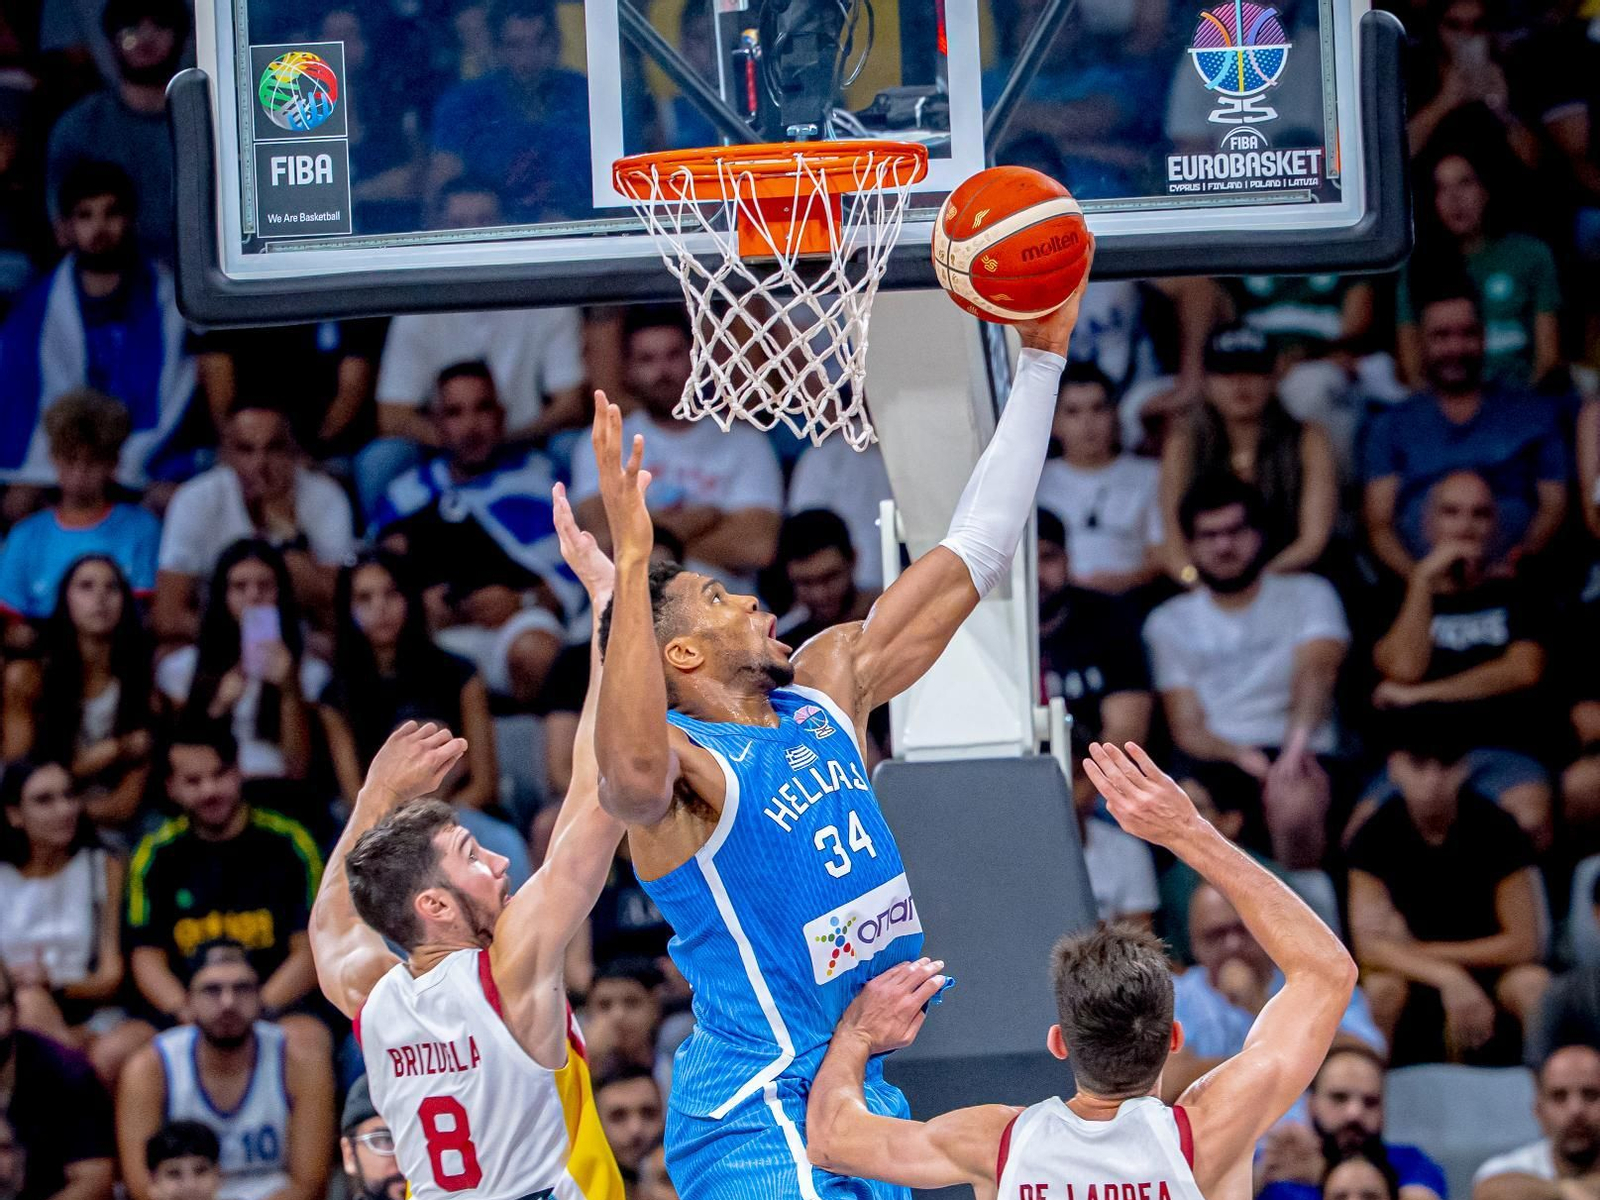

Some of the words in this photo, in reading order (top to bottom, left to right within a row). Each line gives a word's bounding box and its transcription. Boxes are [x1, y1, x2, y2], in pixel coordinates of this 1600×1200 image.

[1230, 136, 1258, 150] FIBA
[270, 153, 334, 186] FIBA
[1167, 149, 1322, 181] EUROBASKET
[1169, 183, 1201, 192] CYPRUS
[1207, 181, 1242, 190] FINLAND
[1250, 178, 1281, 188] POLAND
[1288, 177, 1319, 187] LATVIA
[267, 213, 282, 223] We
[283, 213, 298, 223] Are
[299, 210, 341, 222] Basketball
[1021, 231, 1079, 262] molten
[763, 760, 869, 833] HELLAS
[813, 810, 877, 879] 34
[417, 1095, 483, 1192] 8
